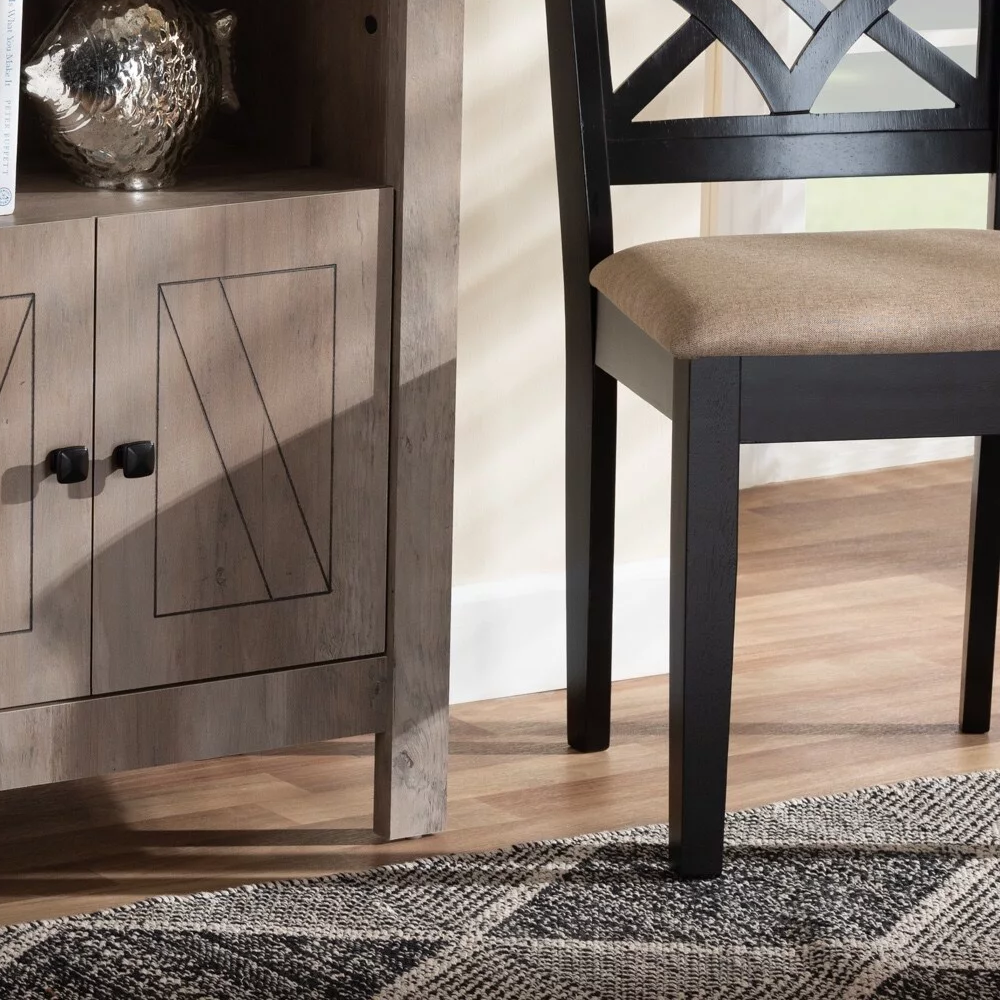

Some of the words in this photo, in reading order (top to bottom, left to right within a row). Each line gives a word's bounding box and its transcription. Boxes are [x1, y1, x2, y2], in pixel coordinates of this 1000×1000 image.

[8, 0, 16, 7] Is
[7, 9, 16, 33] What
[6, 35, 15, 51] You
[5, 54, 14, 78] Make
[4, 79, 12, 87] It
[4, 100, 12, 129] PETER
